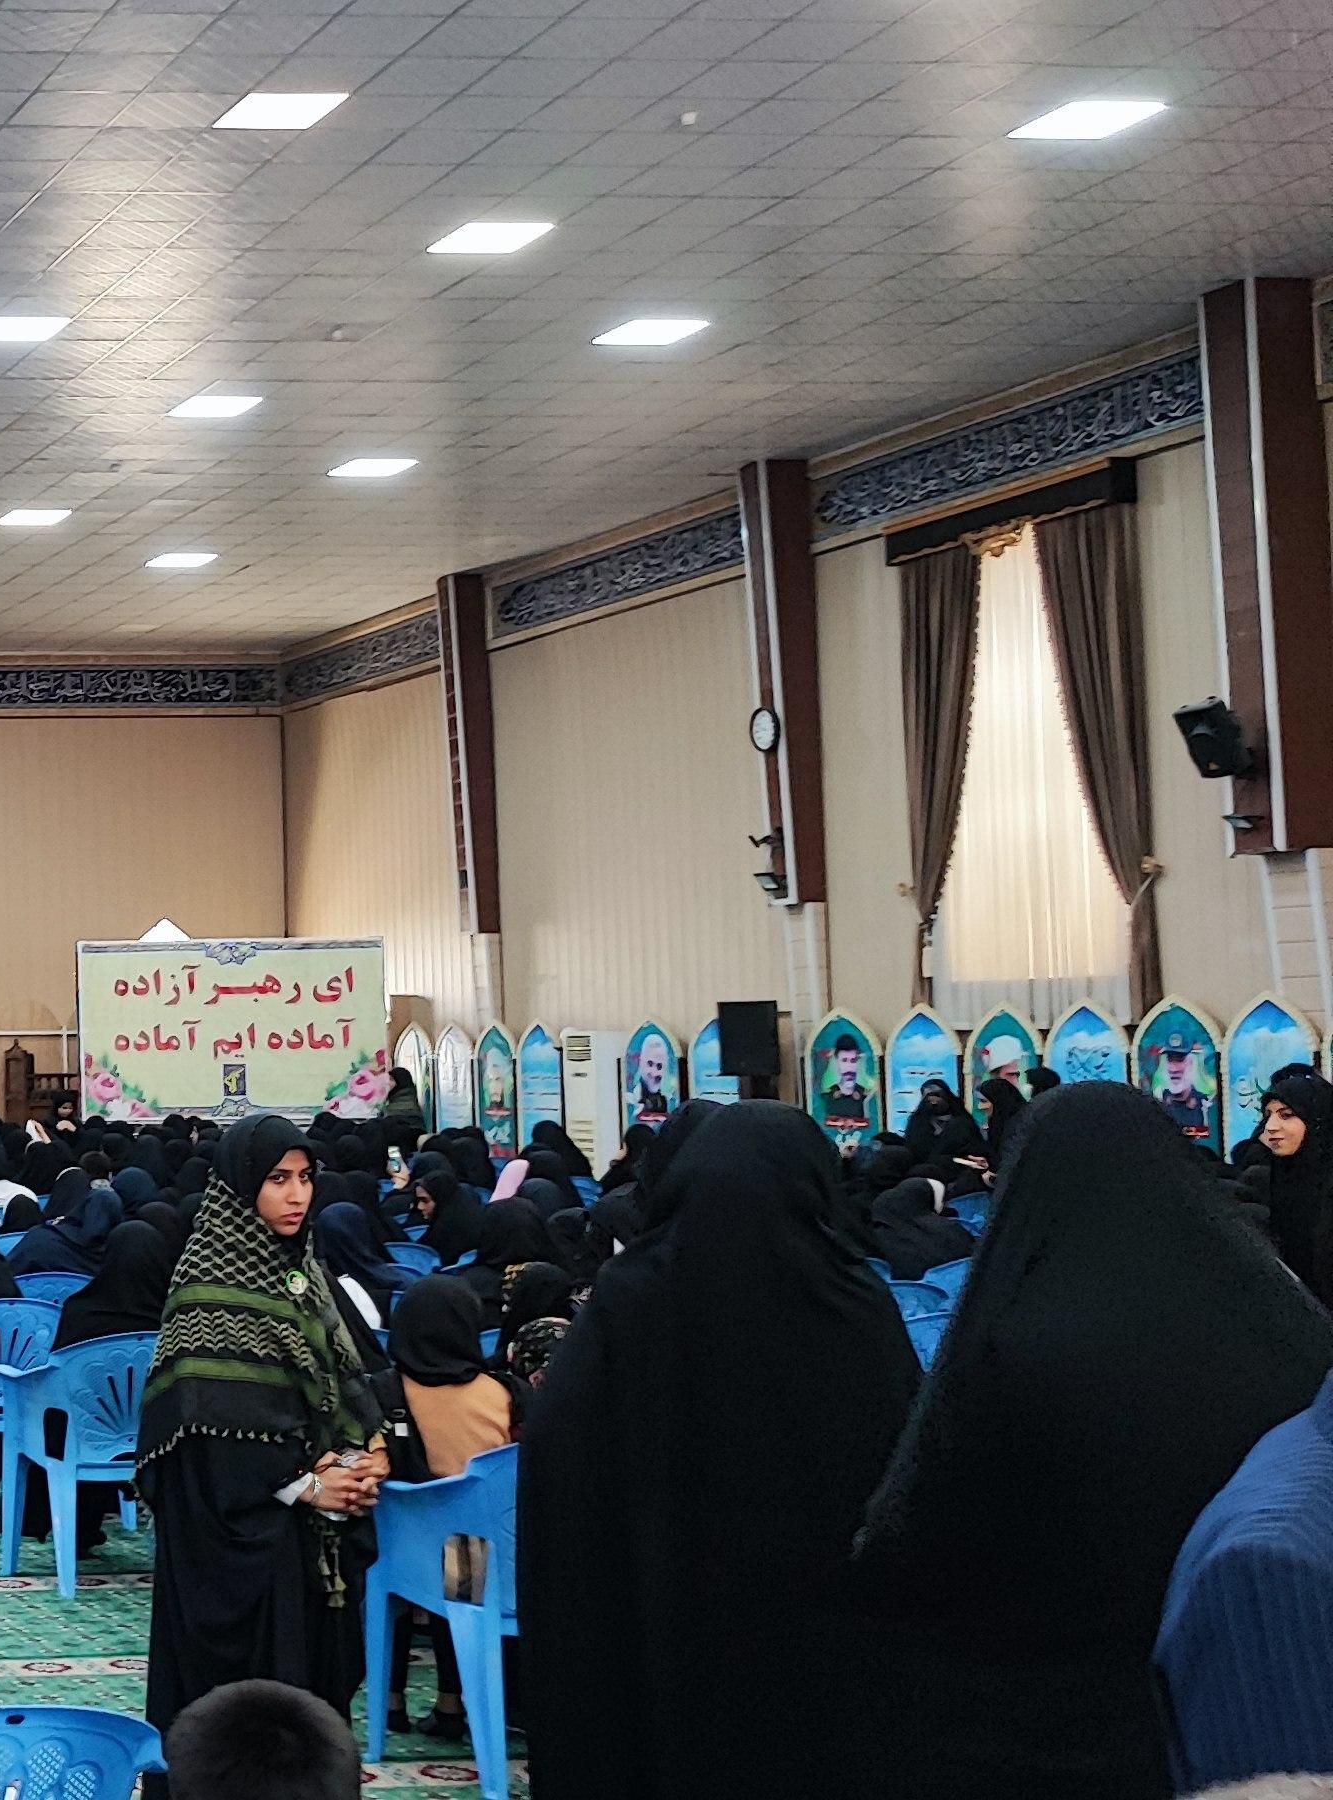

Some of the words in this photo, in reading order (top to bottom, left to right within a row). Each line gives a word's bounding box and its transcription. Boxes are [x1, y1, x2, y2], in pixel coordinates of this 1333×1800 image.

[114, 964, 201, 1005] آزاده
[204, 973, 301, 1005] رهبر
[312, 965, 354, 1003] ای
[114, 1019, 201, 1051] آماده
[213, 1022, 255, 1061] ایم
[267, 1017, 357, 1050] آماده
